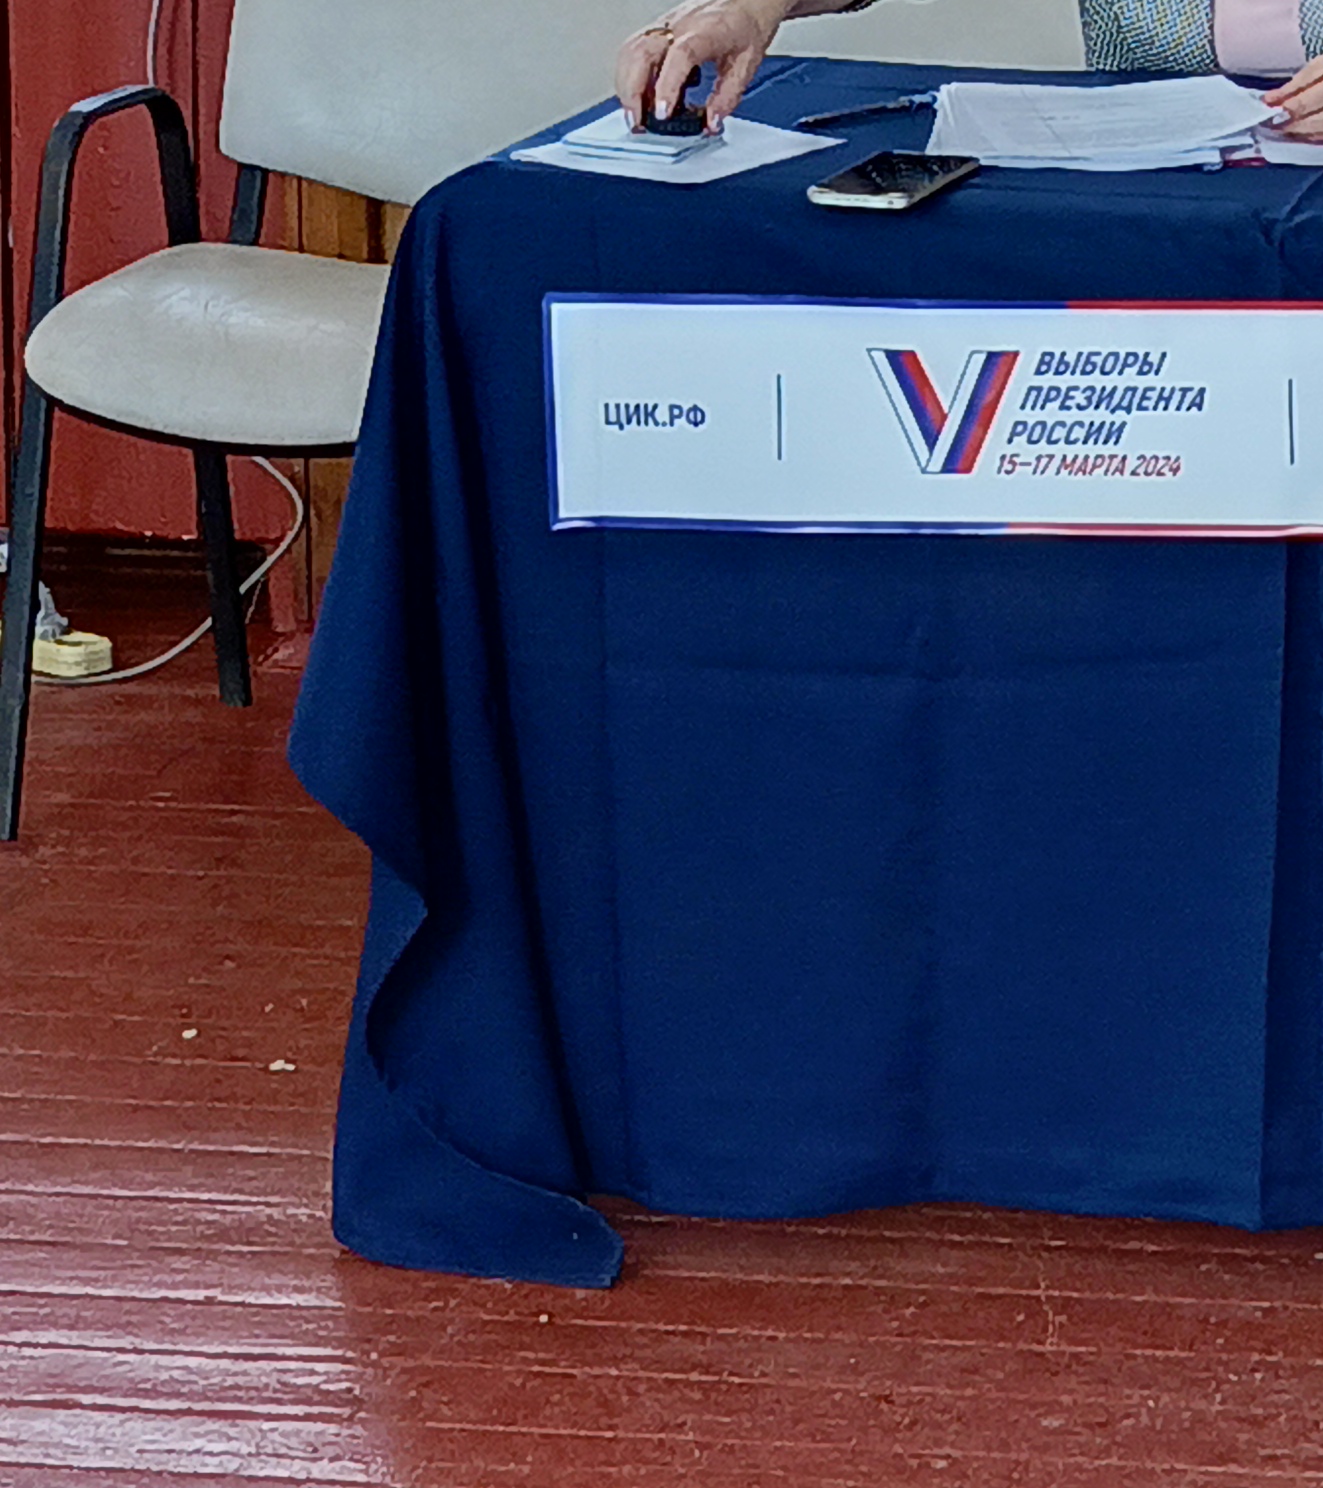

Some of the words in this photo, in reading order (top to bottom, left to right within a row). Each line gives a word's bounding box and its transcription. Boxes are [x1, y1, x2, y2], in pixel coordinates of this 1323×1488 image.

[1033, 351, 1168, 377] ВЫБОРЫ
[1019, 386, 1207, 416] ПРЕЗИДЕНТА
[603, 403, 706, 431] ЦИК.РФ
[1006, 420, 1128, 446] РОССИИ
[1057, 454, 1127, 477] МАРТА
[1129, 454, 1182, 478] 2024
